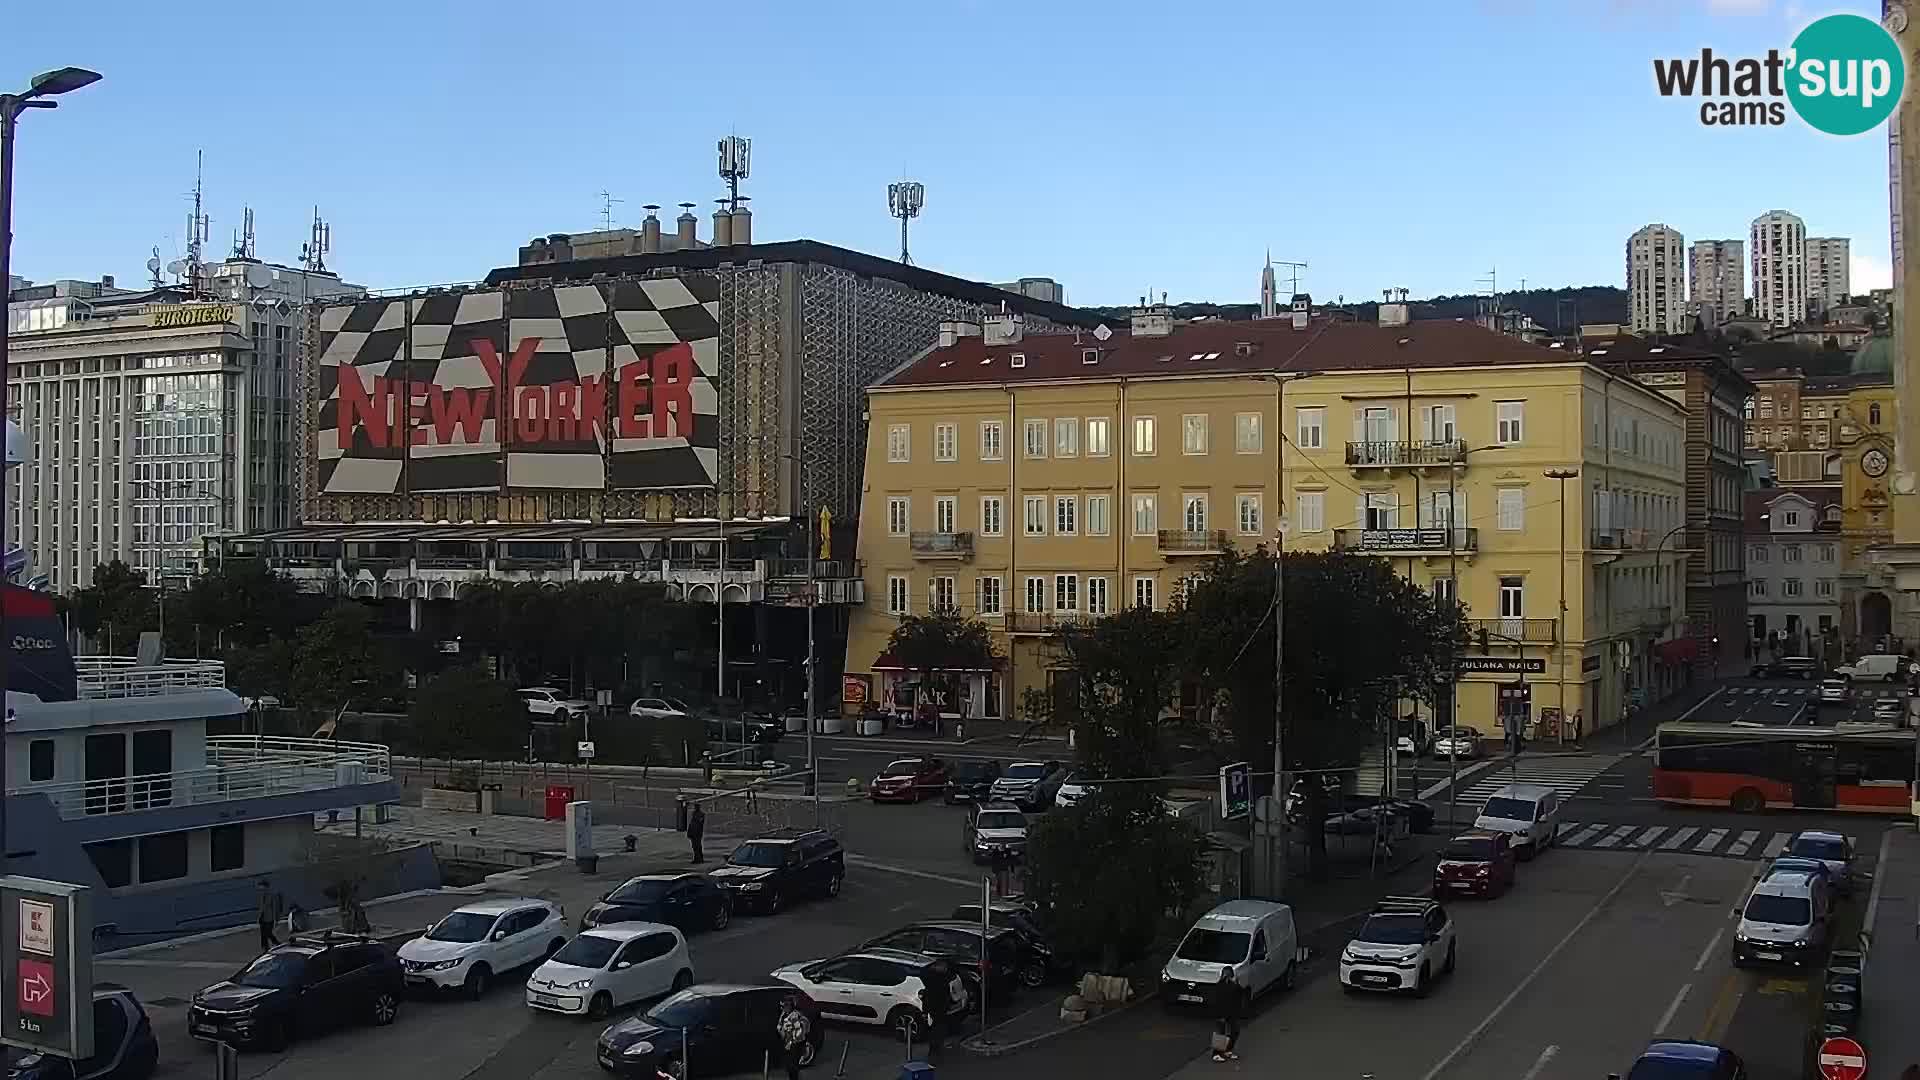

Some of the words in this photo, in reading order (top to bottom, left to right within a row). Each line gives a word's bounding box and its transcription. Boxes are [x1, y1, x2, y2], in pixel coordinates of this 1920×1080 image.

[154, 306, 234, 326] EUROHERC
[338, 360, 494, 449] NEW
[470, 337, 693, 444] YORKER
[1459, 661, 1504, 669] JULIANA
[1508, 662, 1541, 670] NAILS
[20, 1018, 26, 1030] 5
[27, 1020, 40, 1032] km
